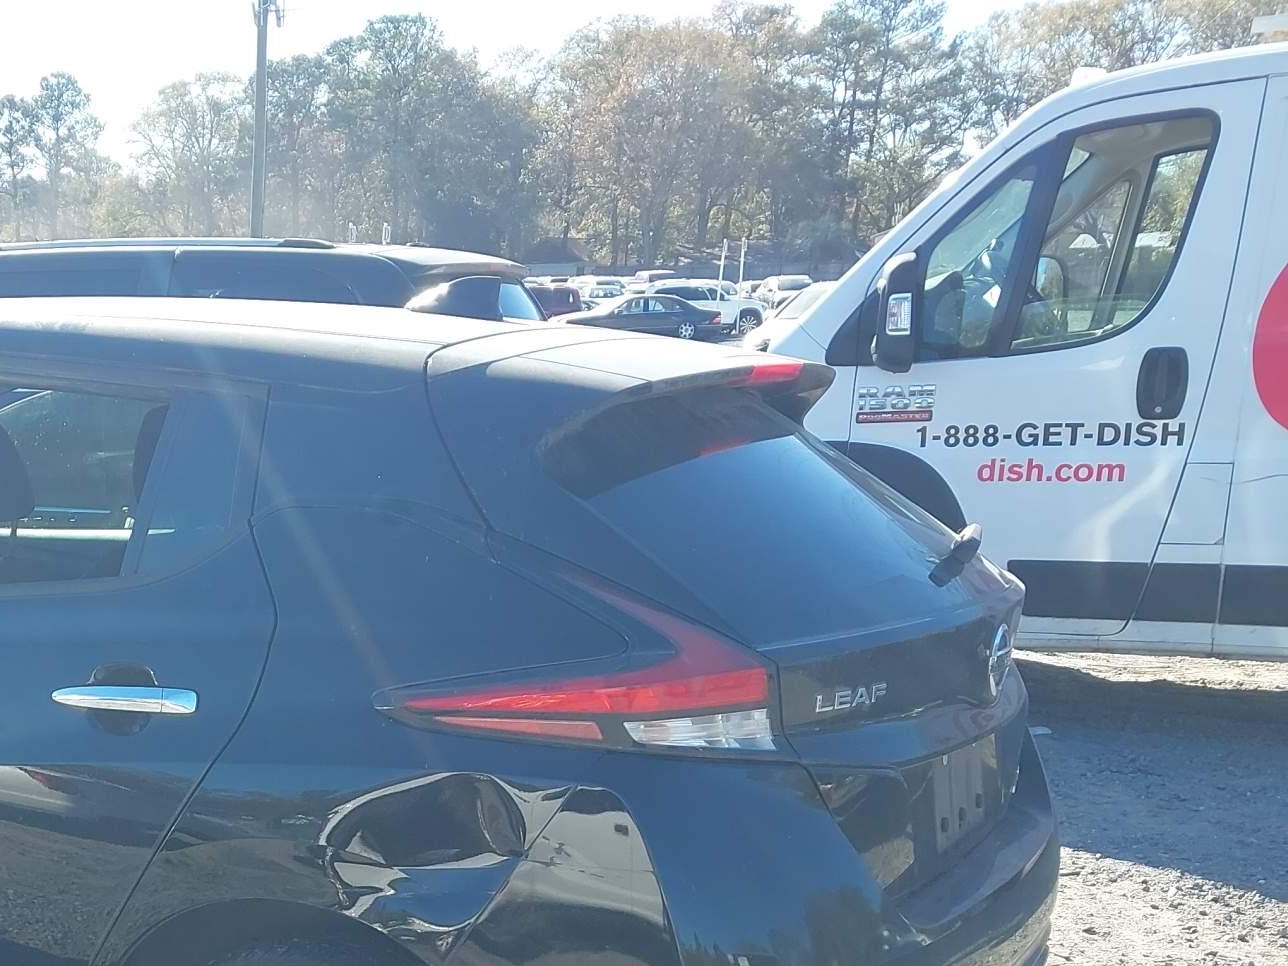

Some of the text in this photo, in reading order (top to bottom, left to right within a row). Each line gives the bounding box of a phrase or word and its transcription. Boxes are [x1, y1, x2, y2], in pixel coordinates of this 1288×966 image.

[858, 384, 936, 399] RAM
[858, 397, 935, 411] 1500
[916, 422, 1186, 448] 1-888-GET-DISH
[977, 458, 1126, 482] dish.com
[815, 682, 888, 713] LEAF
